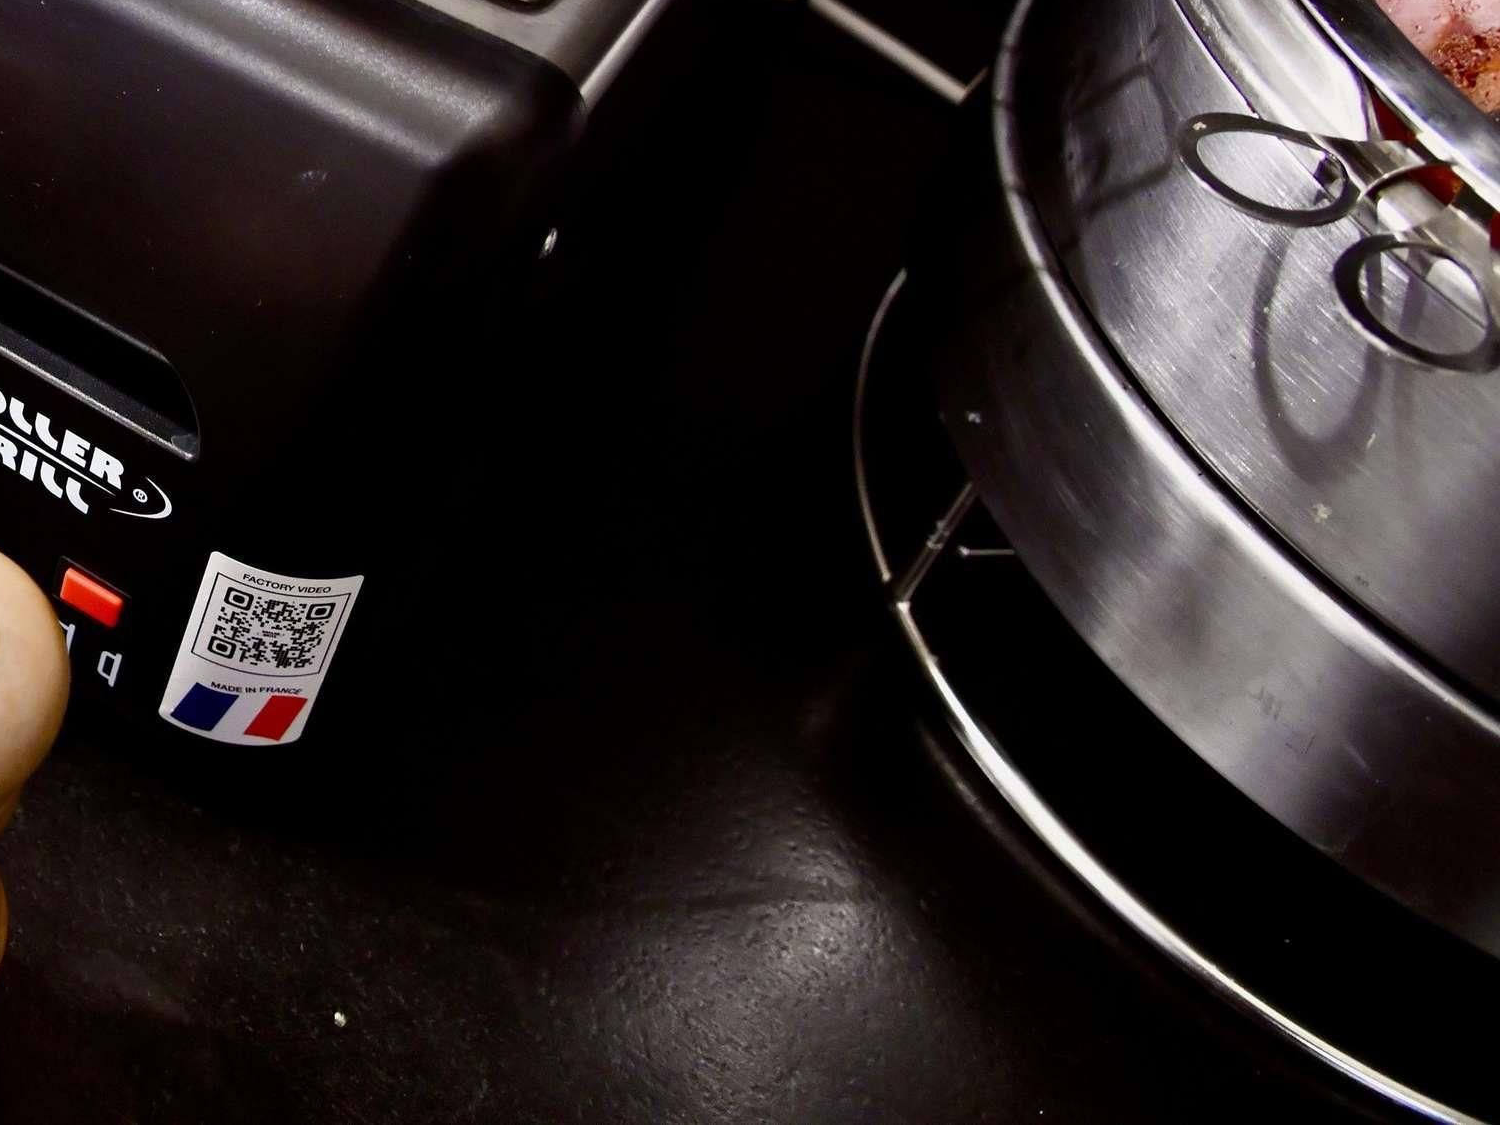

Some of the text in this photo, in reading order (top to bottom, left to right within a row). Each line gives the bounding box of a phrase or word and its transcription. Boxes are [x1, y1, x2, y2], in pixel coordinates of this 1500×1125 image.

[243, 573, 332, 594] FACTORY VIDEO
[209, 680, 242, 694] MADE
[259, 686, 303, 696] FRANCE
